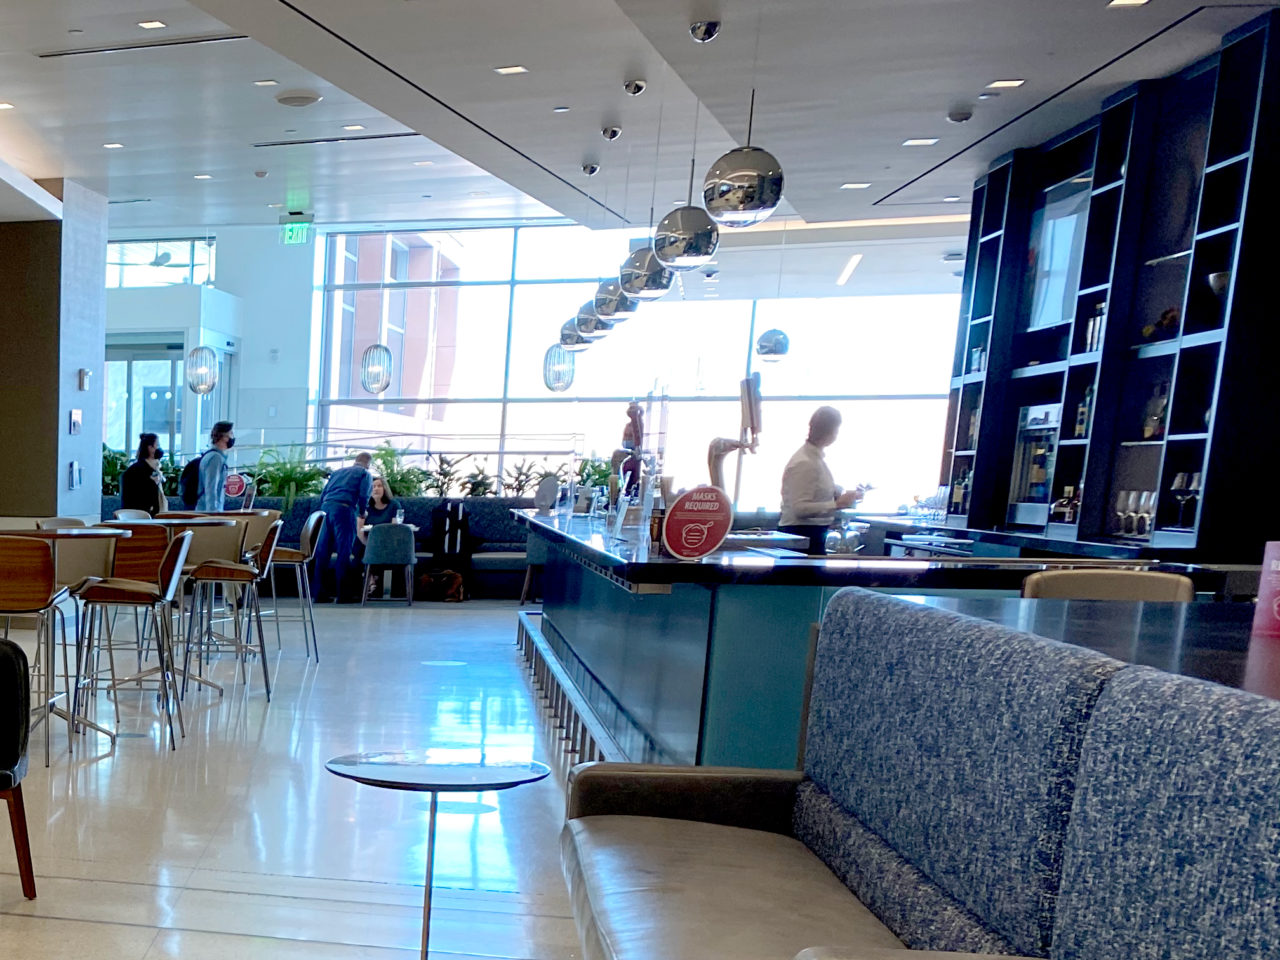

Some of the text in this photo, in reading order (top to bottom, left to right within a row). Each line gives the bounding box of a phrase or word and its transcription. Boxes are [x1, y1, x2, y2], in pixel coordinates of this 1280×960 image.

[284, 223, 308, 244] EXIT
[691, 492, 717, 501] MASKS
[684, 501, 720, 511] REQUIRED
